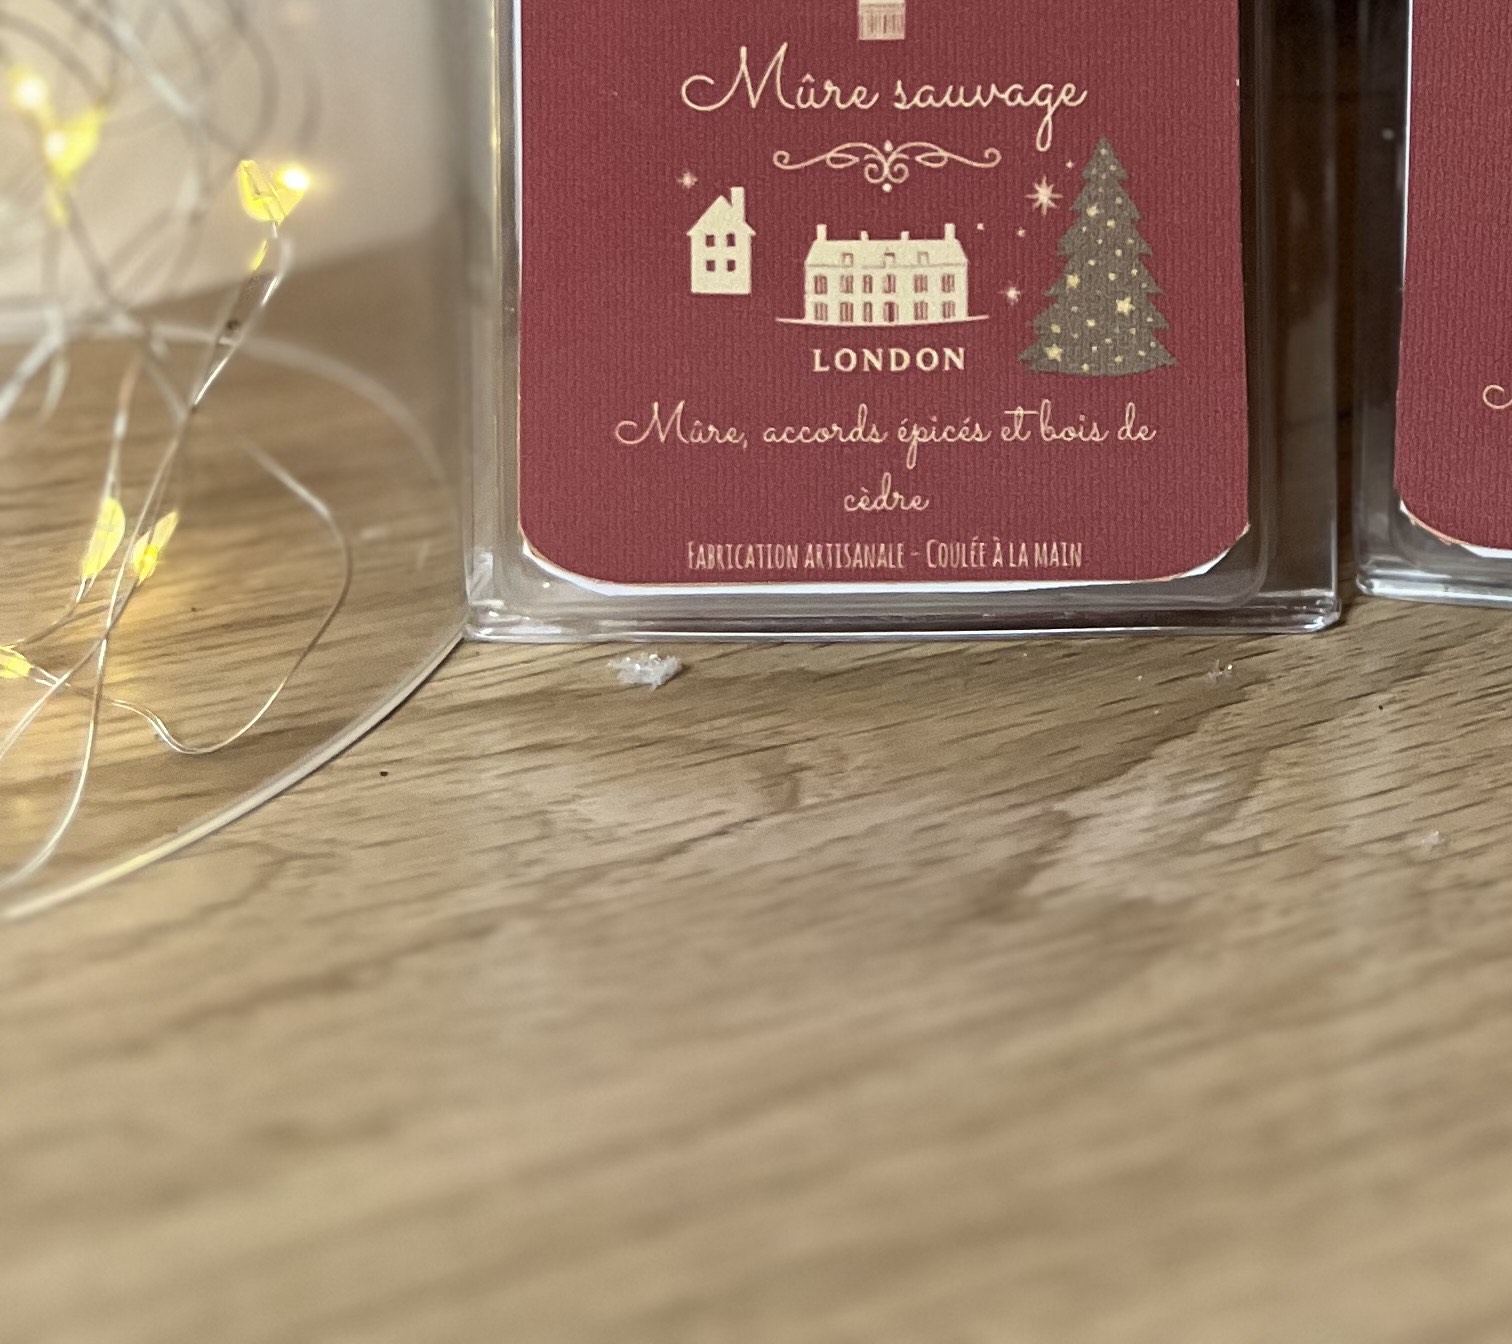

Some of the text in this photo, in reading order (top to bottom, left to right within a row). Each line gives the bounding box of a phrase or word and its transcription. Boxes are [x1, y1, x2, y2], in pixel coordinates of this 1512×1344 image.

[680, 41, 1088, 154] Mûre sauvage
[812, 347, 965, 372] LONDON
[614, 399, 1157, 470] Mûre, accords épicés et bois de
[843, 471, 930, 512] cèdre
[687, 540, 799, 570] FABRICATION
[803, 542, 905, 569] ARTISANALE
[926, 535, 987, 569] COULÉE
[992, 536, 1004, 568] À
[1009, 542, 1029, 568] LA
[1034, 541, 1082, 568] MAIN
